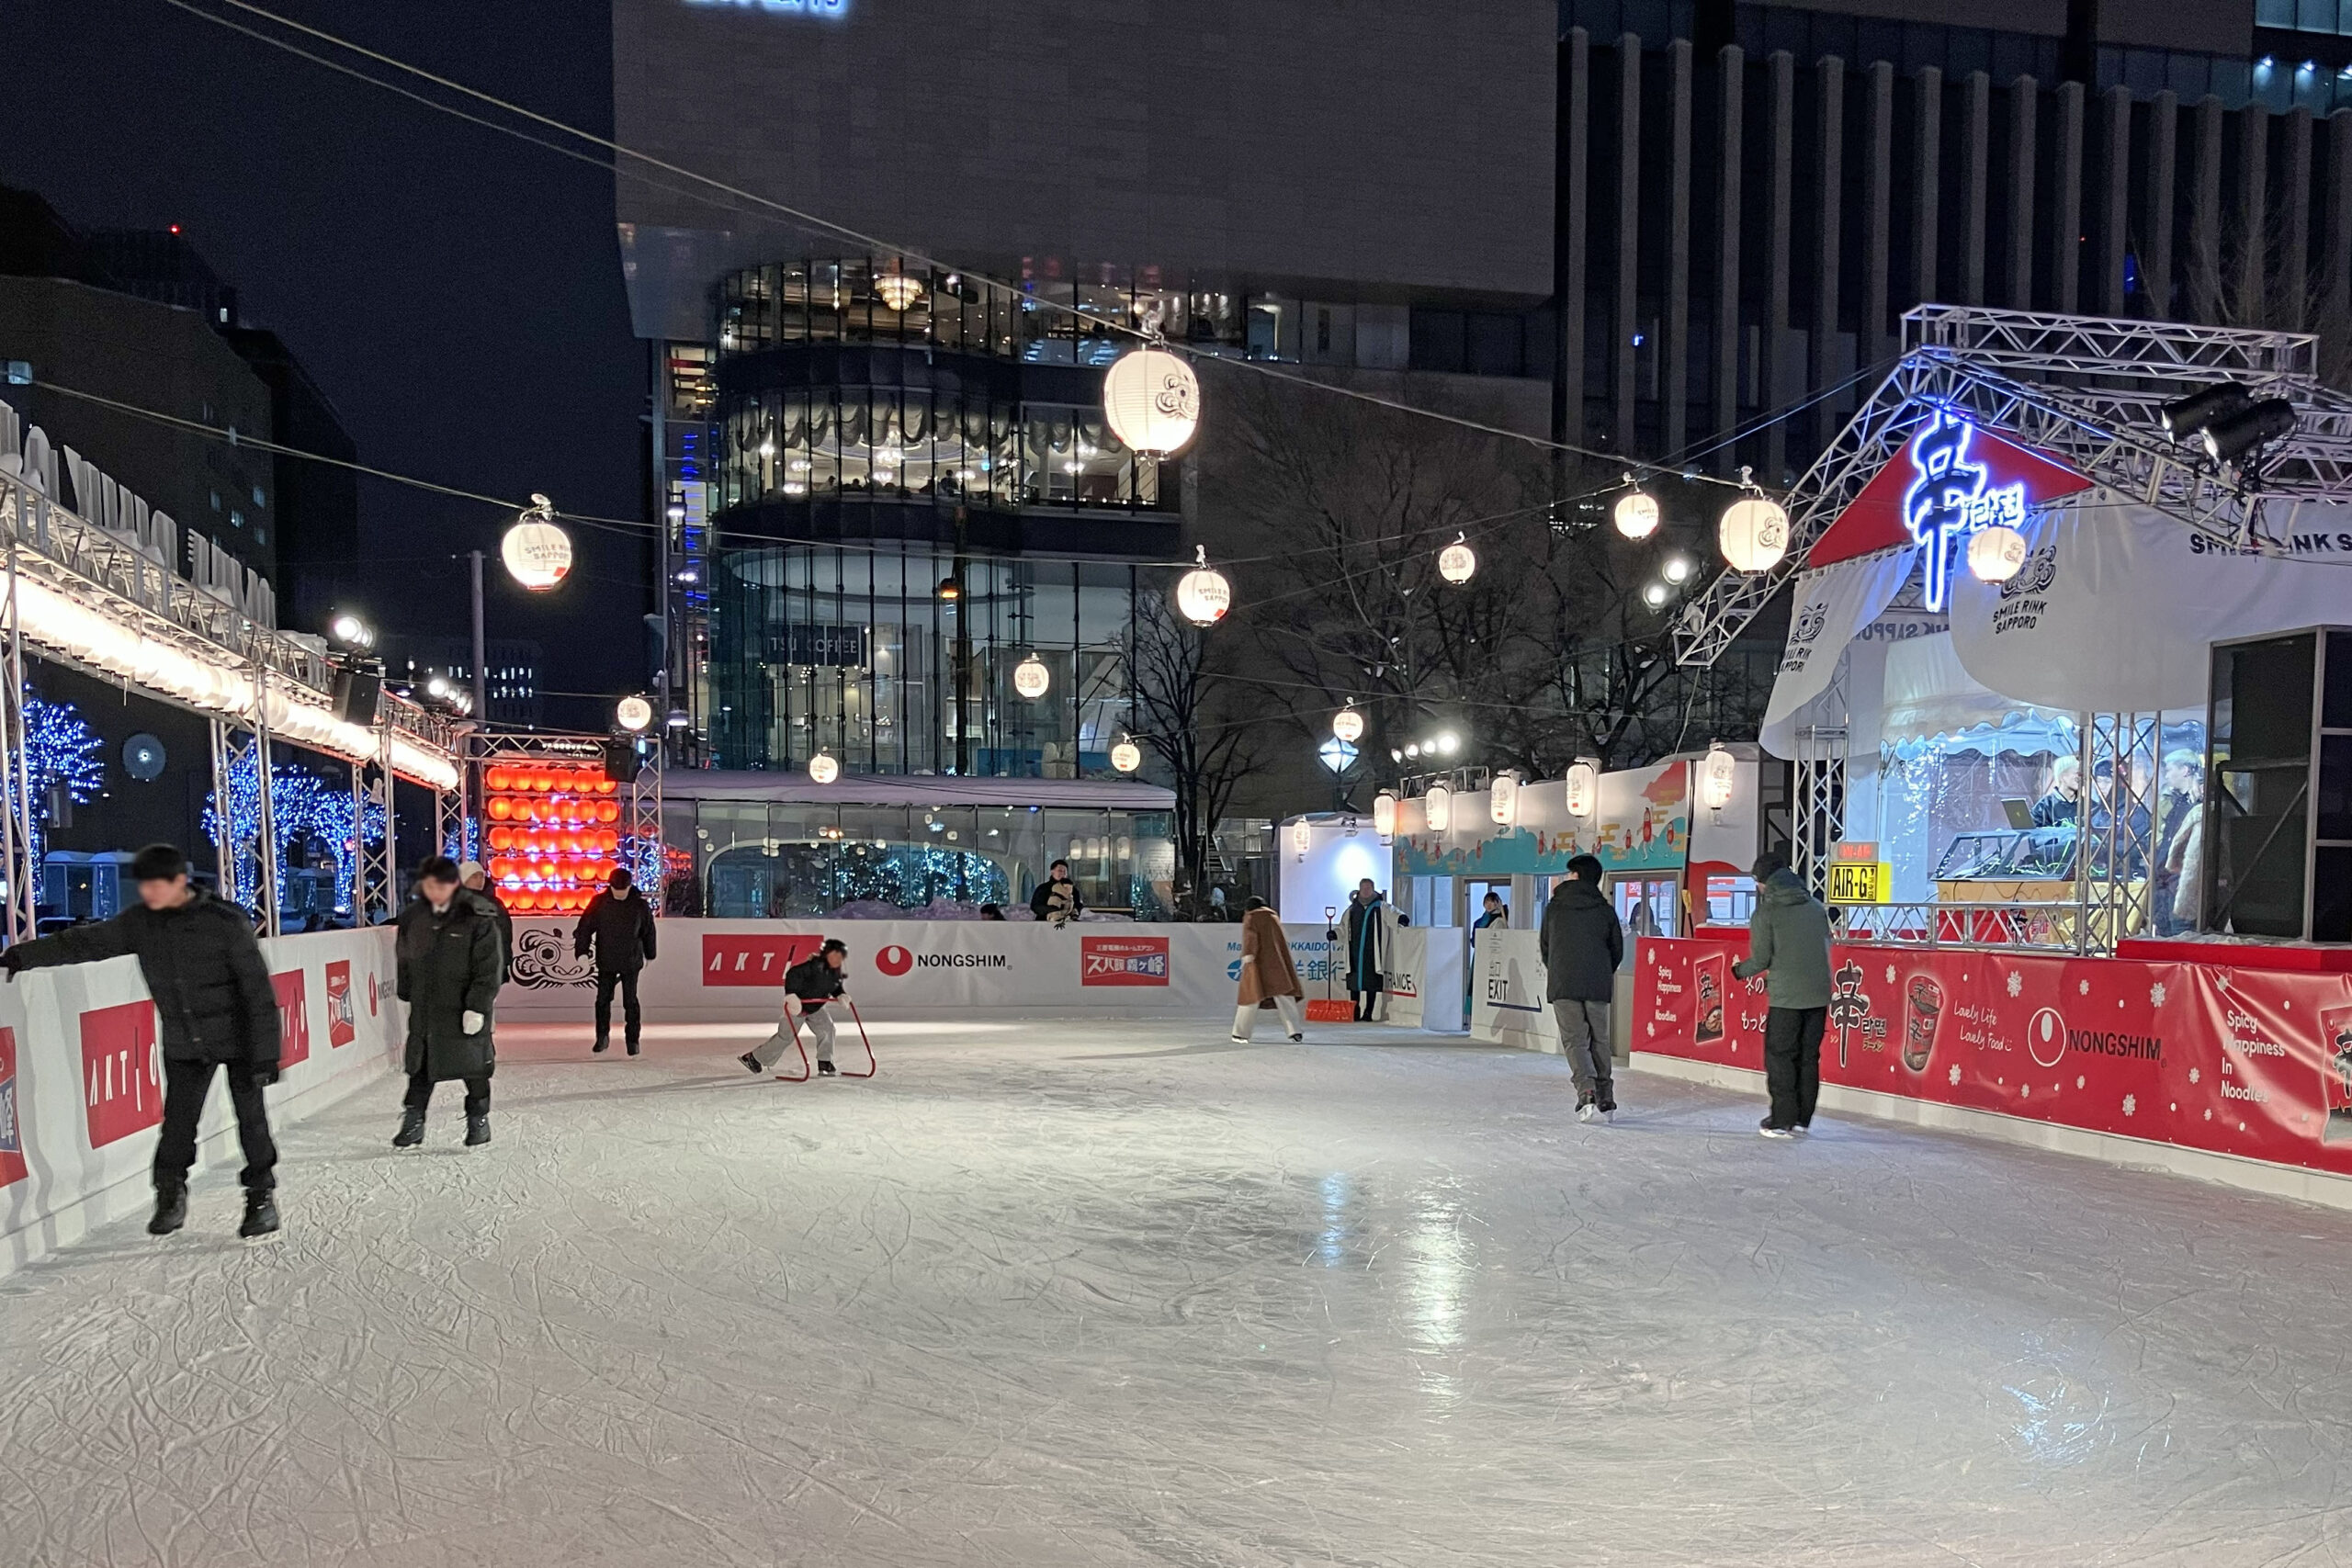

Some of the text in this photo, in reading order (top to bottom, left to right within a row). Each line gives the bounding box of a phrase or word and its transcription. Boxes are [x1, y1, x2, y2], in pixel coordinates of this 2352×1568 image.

[1993, 600, 2047, 623] SMILE RINK
[1996, 615, 2037, 634] SAPPORO
[1287, 942, 1329, 952] KKAIDO
[918, 953, 1006, 967] NONGSHIM
[1383, 971, 1411, 991] TRANCE
[1487, 979, 1509, 1000] EXIT
[1829, 959, 1870, 1068] 辛
[1954, 999, 1979, 1025] Lovely
[1980, 1007, 1997, 1029] Life
[2227, 1010, 2257, 1034] Spicy
[1960, 1024, 2005, 1051] Lovely Food
[2068, 1029, 2162, 1061] NONGSHIM
[2223, 1033, 2285, 1058] Happiness
[2222, 1056, 2233, 1075] In
[2221, 1079, 2268, 1103] Noodles
